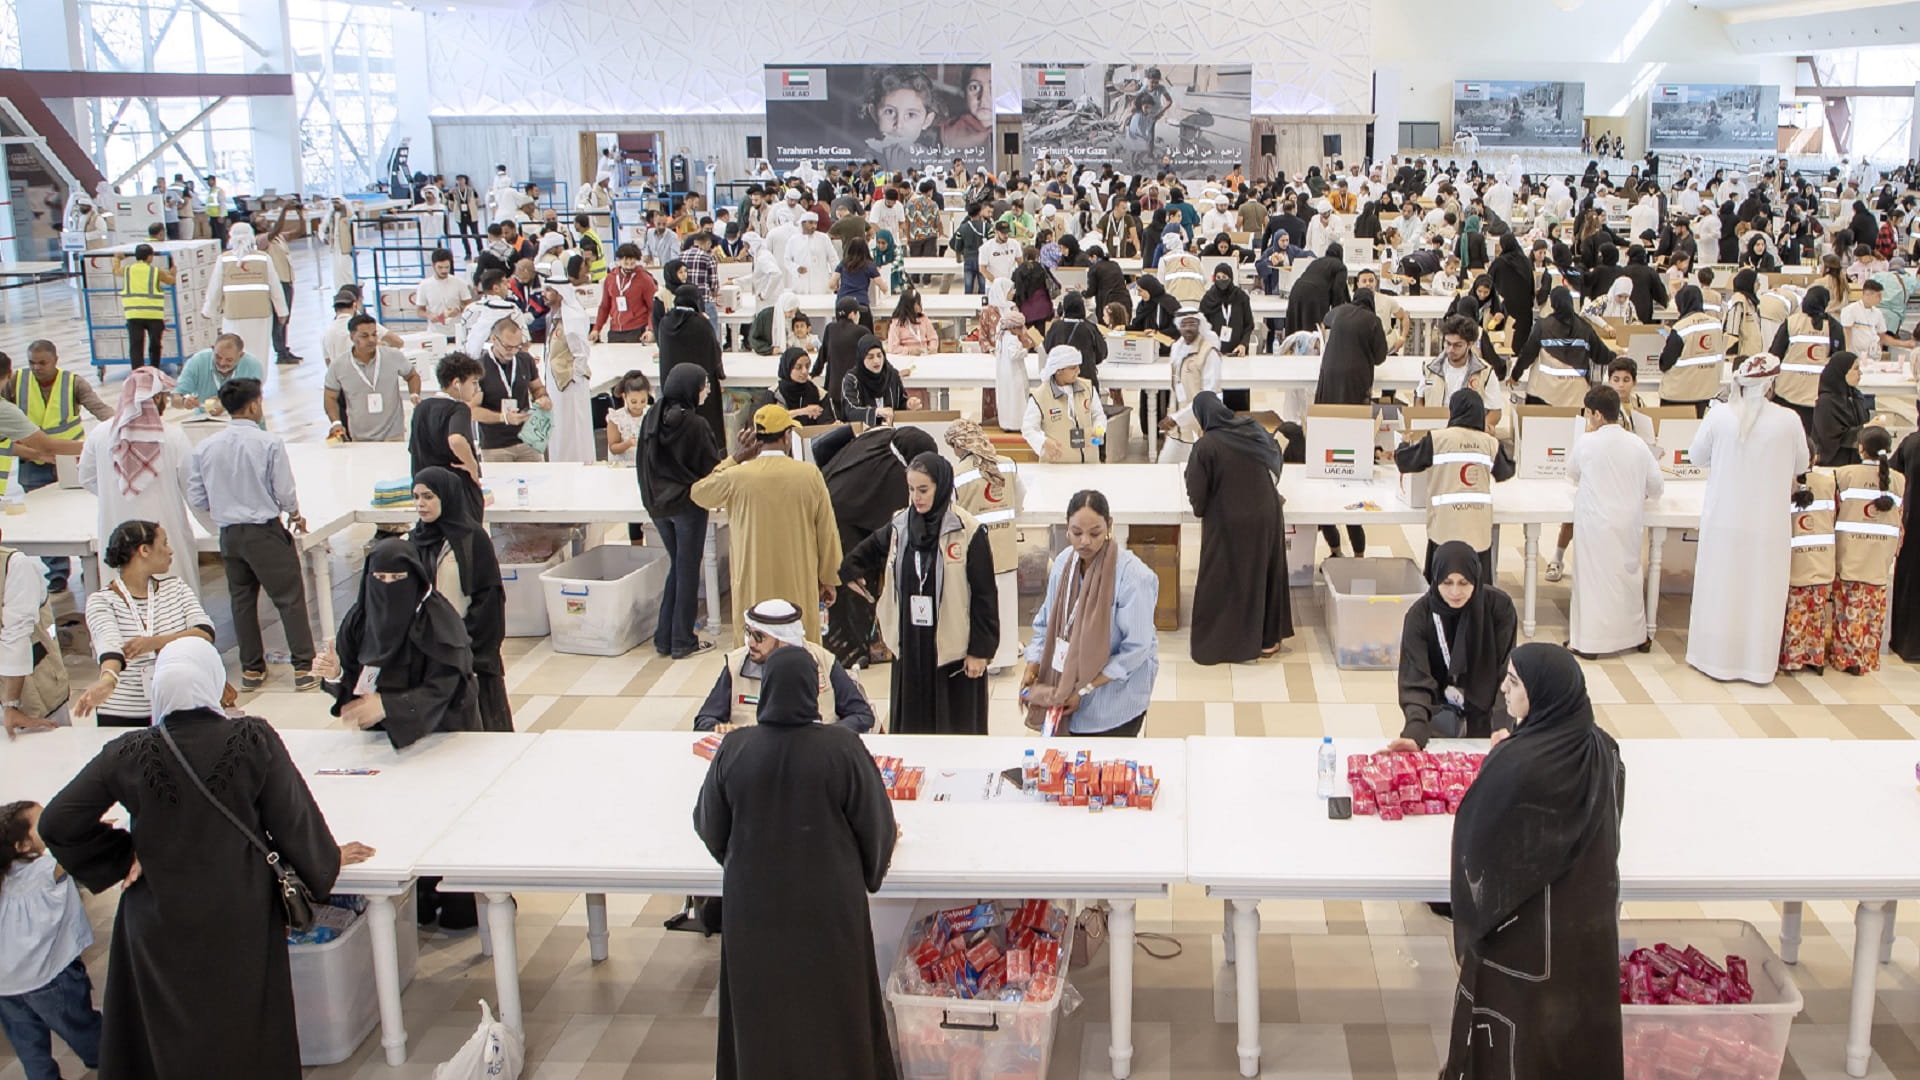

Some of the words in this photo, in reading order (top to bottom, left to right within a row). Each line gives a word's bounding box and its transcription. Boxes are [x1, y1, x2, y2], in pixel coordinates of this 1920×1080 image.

[776, 146, 814, 155] Tarahum
[819, 145, 830, 155] for
[831, 146, 851, 155] Gaza
[1073, 146, 1085, 155] for
[1086, 146, 1108, 155] Gaza
[1324, 467, 1341, 475] UAE
